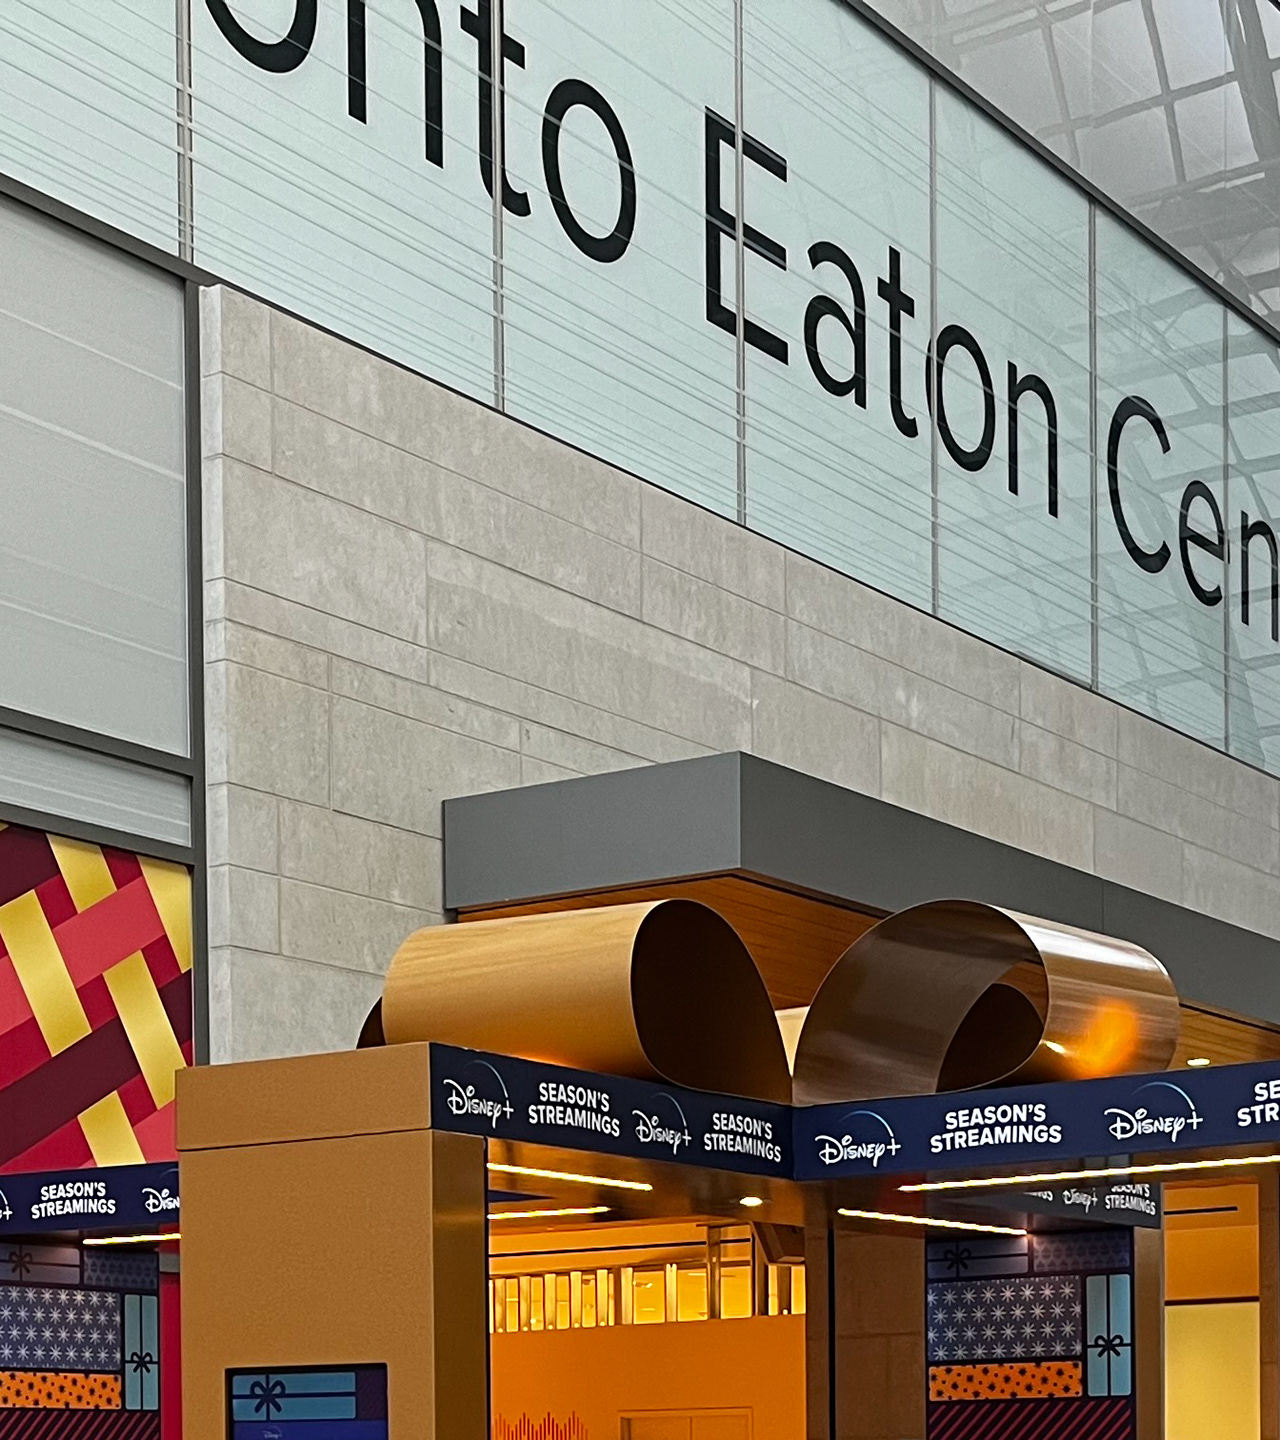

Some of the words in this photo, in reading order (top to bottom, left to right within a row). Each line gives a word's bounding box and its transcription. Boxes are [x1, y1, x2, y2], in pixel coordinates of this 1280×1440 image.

[704, 105, 1059, 520] Eaton
[443, 1079, 514, 1128] Disney+
[539, 1082, 610, 1113] SEASON'S
[528, 1105, 620, 1138] STREAMINGS
[712, 1112, 772, 1140] SEASON'S
[945, 1103, 1047, 1129] SEASON'S
[1104, 1108, 1203, 1142] Disney+
[632, 1110, 692, 1155] Disney+
[704, 1132, 781, 1163] STREAMINGS
[930, 1125, 1062, 1153] STREAMINGS
[815, 1135, 901, 1167] Disney+
[40, 1182, 106, 1201] SEASON'S
[142, 1187, 179, 1213] Disn
[1105, 1194, 1156, 1216] STREAMINGS
[31, 1199, 116, 1219] STREAMINGS
